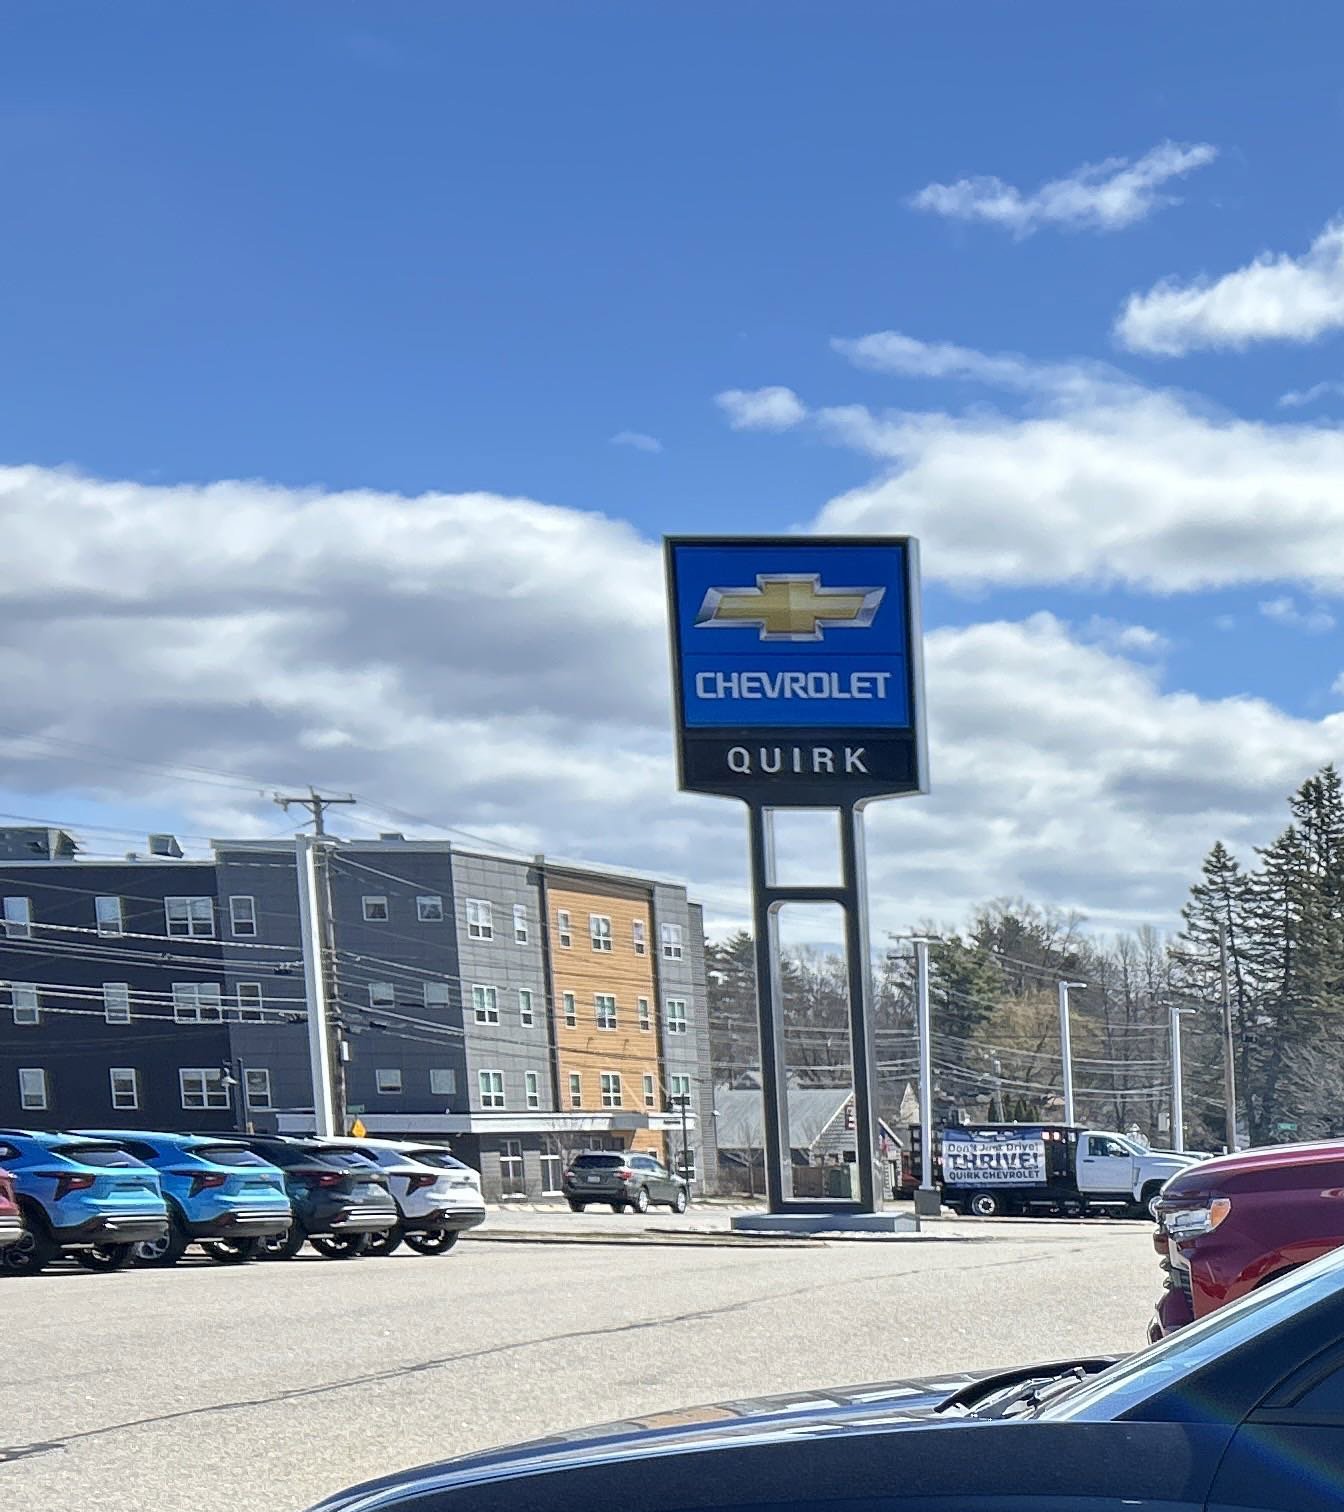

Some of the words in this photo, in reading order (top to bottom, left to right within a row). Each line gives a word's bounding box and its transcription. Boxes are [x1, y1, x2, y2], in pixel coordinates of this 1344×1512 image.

[695, 671, 891, 699] CHEVROLET
[727, 746, 869, 774] QUIRK
[948, 1152, 1039, 1170] THRIVE!
[949, 1171, 981, 1180] QUIRK
[982, 1170, 1040, 1180] CHEVROLET
